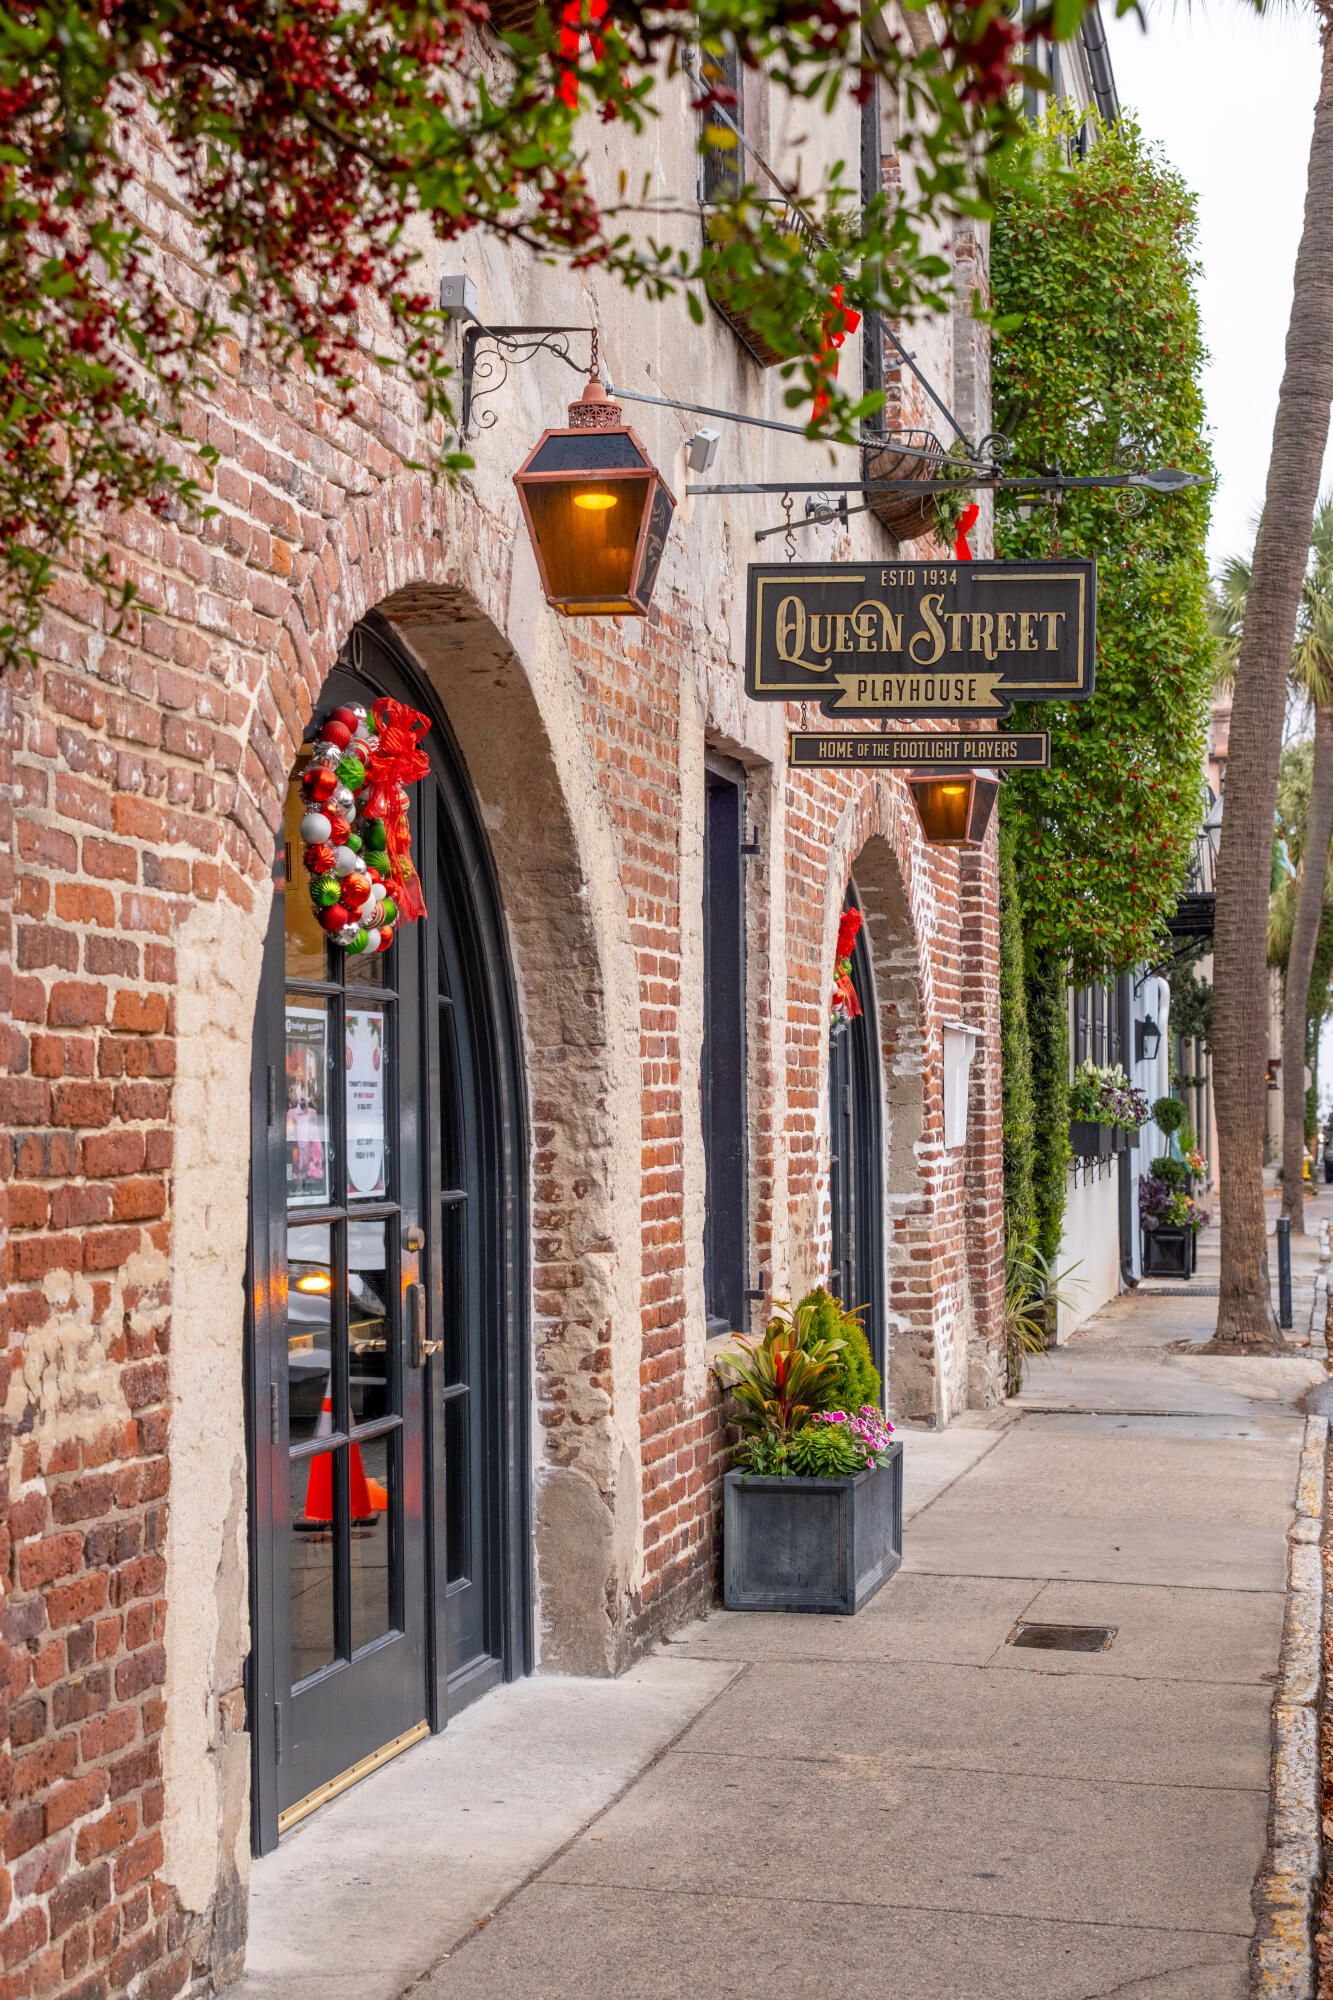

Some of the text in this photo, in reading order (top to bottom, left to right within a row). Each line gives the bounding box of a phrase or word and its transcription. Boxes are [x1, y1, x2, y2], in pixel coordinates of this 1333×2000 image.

[881, 568, 958, 587] ESTD 1934
[857, 678, 977, 702] PLAYHOUSE
[819, 741, 1018, 759] HOME OF THE FOOTLIGHT PLAYERS
